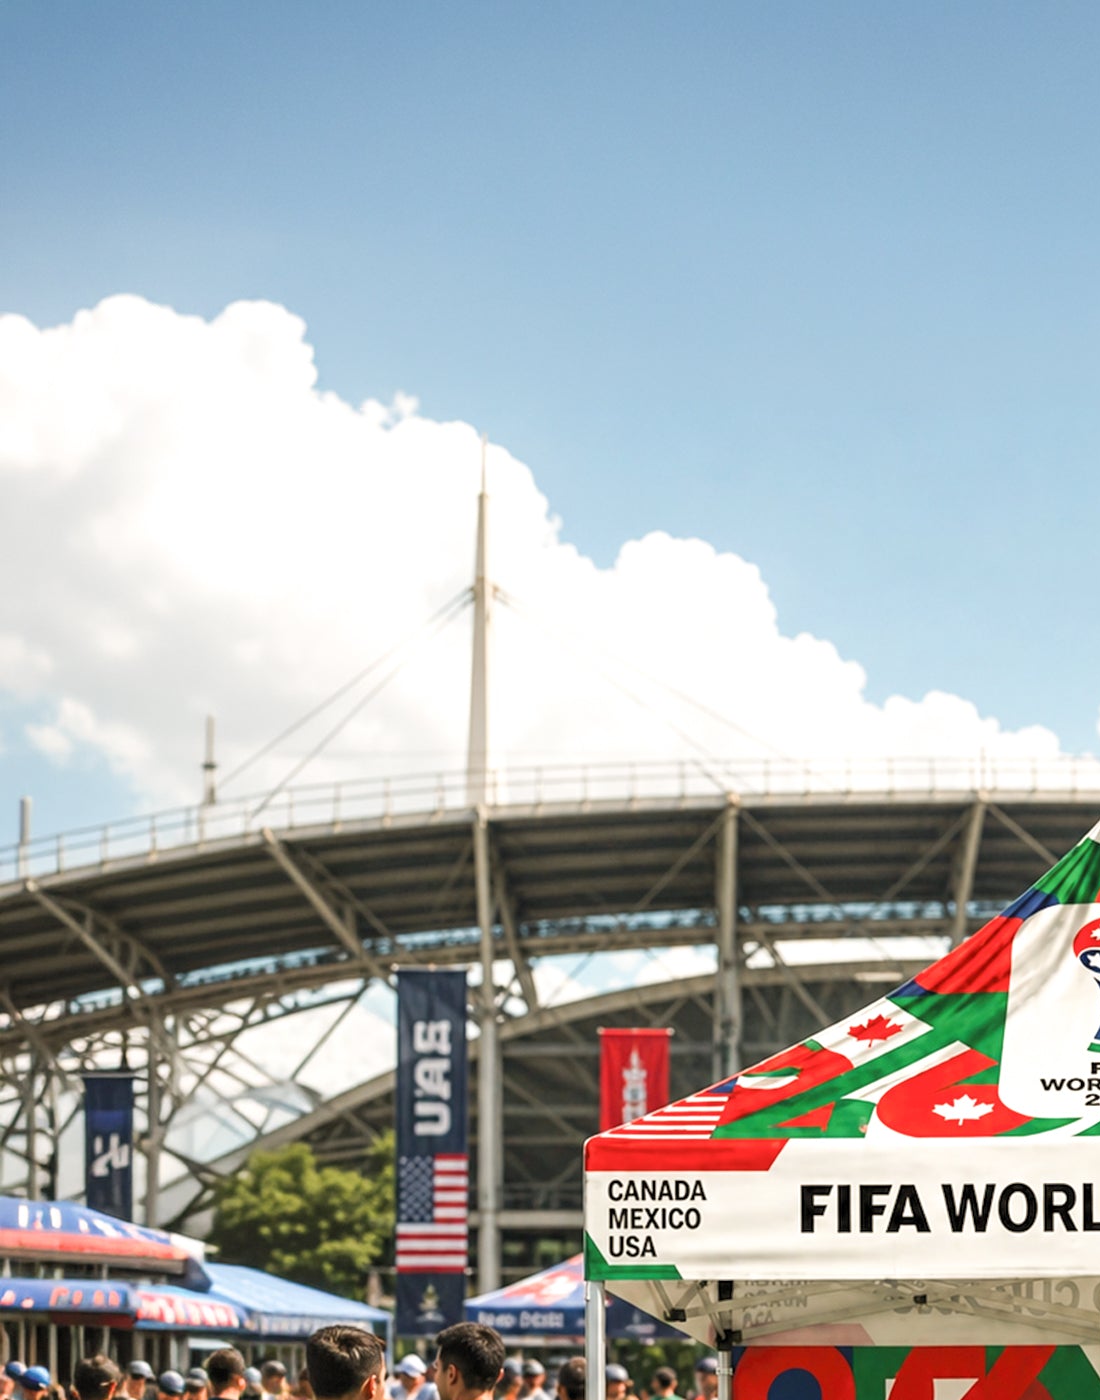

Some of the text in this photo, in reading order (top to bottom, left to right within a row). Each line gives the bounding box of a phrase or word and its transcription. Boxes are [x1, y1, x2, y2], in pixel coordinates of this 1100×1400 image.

[608, 1179, 707, 1202] CANADA
[609, 1207, 701, 1230] MEXICO
[800, 1184, 931, 1233] FIFA
[609, 1235, 657, 1258] USA
